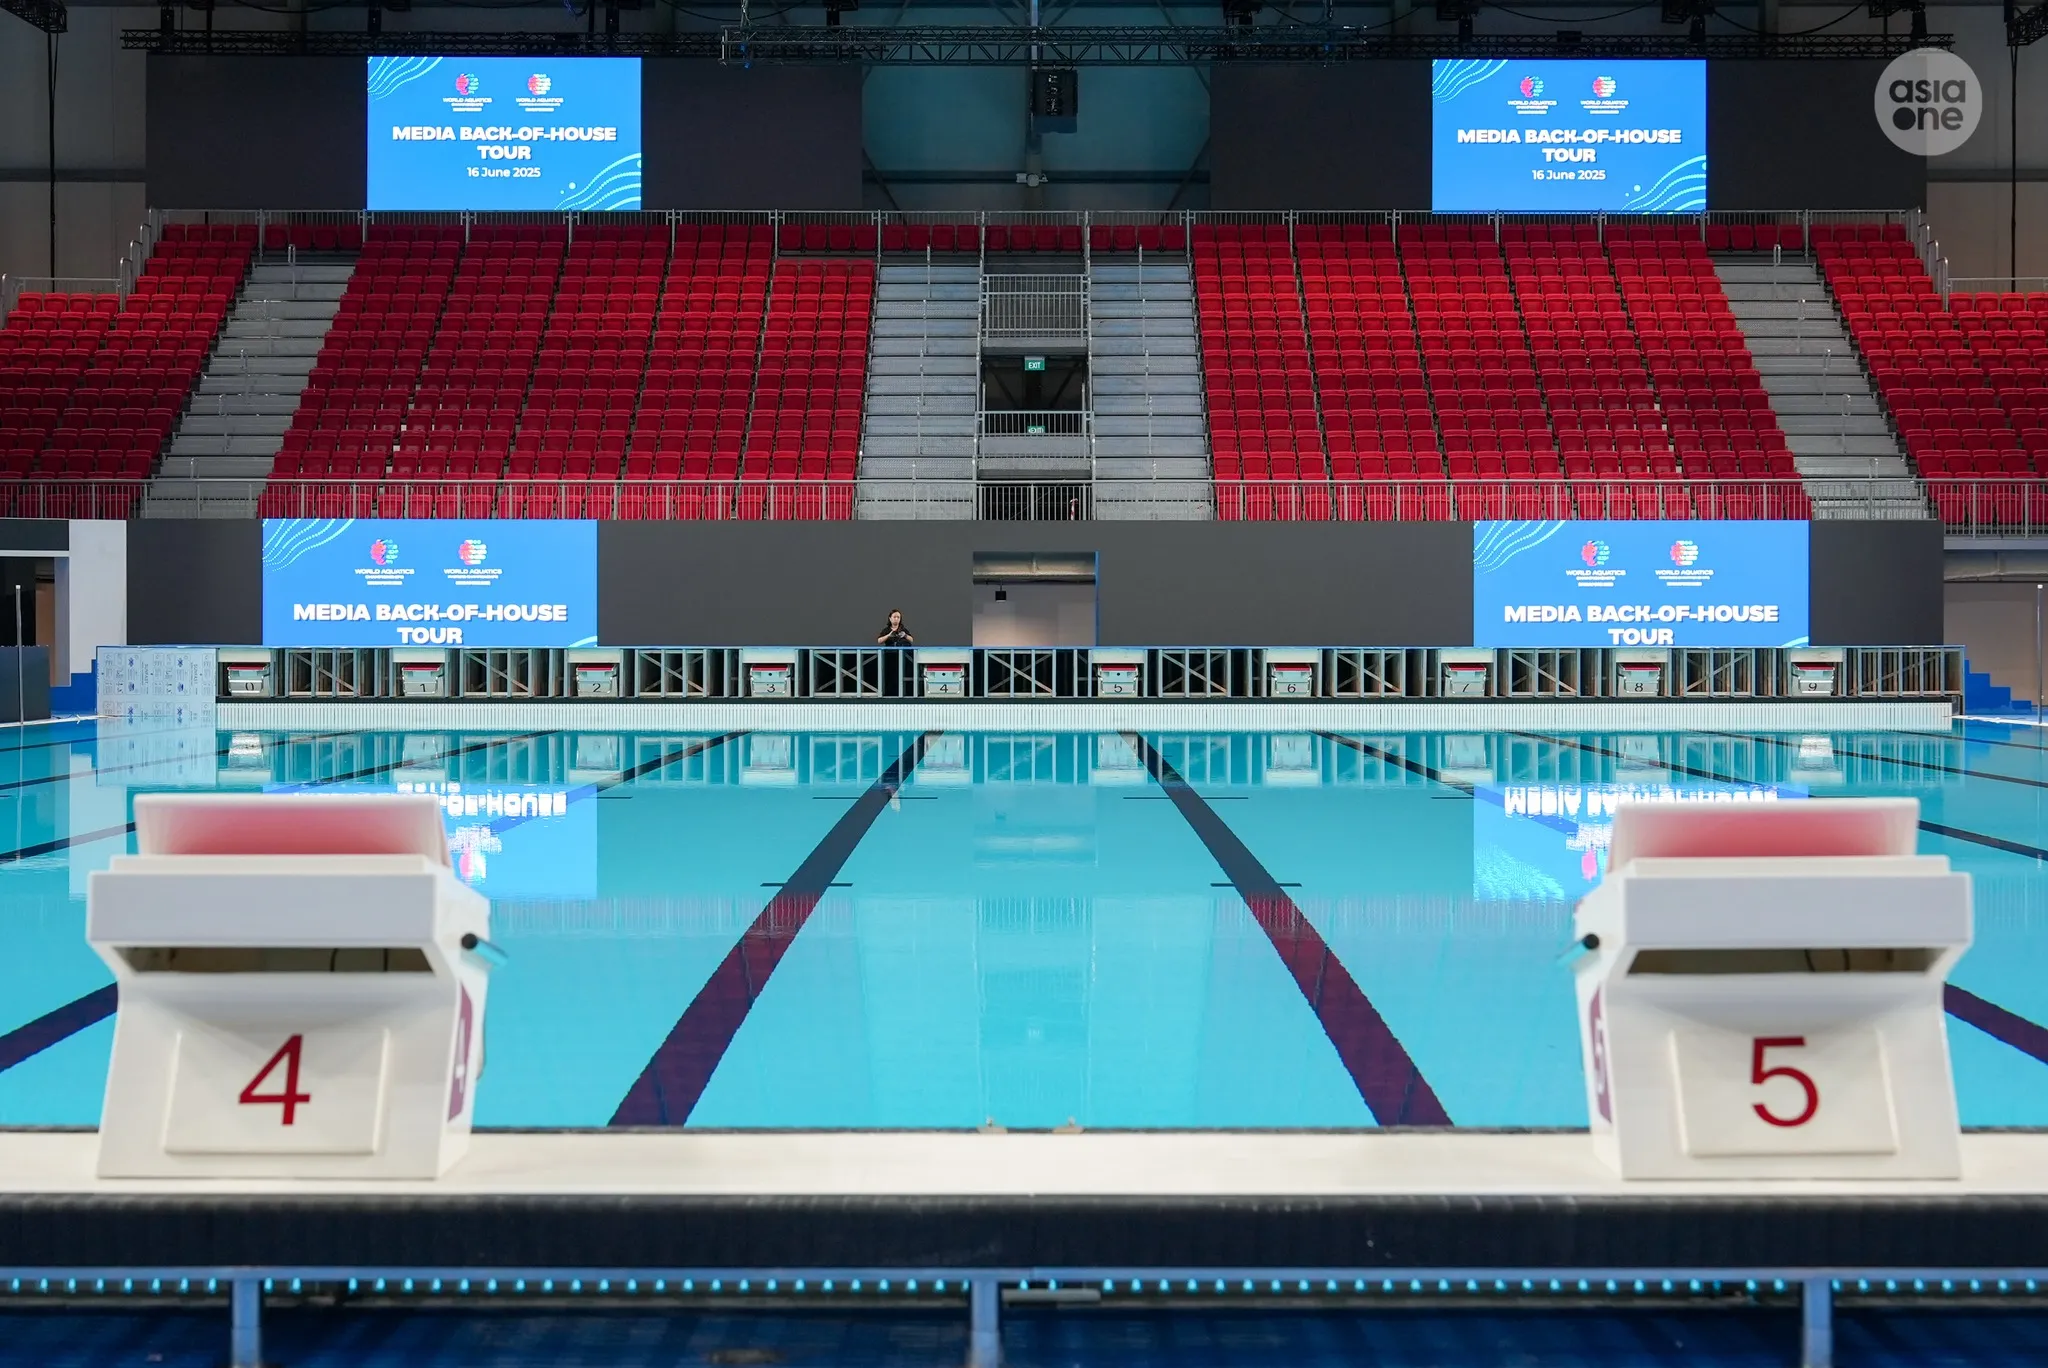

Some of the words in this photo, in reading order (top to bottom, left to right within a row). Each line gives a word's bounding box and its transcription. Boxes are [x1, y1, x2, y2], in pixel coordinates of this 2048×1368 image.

[392, 126, 456, 141] MEDIA
[459, 126, 617, 141] BACK-OF-HOUSE
[1457, 129, 1522, 144] MEDIA
[1524, 129, 1682, 144] BACK-OF-HOUSE
[476, 145, 532, 160] TOUR
[1541, 148, 1597, 163] TOUR
[466, 167, 479, 177] 16
[481, 167, 511, 178] June
[513, 167, 541, 178] 2025
[1531, 169, 1544, 180] 16
[1546, 169, 1576, 180] June
[1578, 169, 1606, 180] 2025
[1028, 361, 1041, 369] EXIT
[293, 603, 371, 622] MEDIA
[375, 603, 567, 622] BACK-OF-HOUSE
[1504, 604, 1583, 623] MEDIA
[1586, 604, 1779, 623] BACK-OF-HOUSE
[396, 626, 463, 644] TOUR
[1607, 627, 1674, 645] TOUR
[420, 683, 426, 692] 1
[593, 683, 602, 692] 2
[767, 683, 776, 693] 3
[939, 683, 949, 693] 4
[1113, 682, 1123, 692] 5
[1287, 683, 1297, 692] 6
[1635, 683, 1644, 692] 8
[1807, 682, 1817, 691] 9
[238, 1034, 311, 1126] 4
[1750, 1036, 1820, 1128] 5
